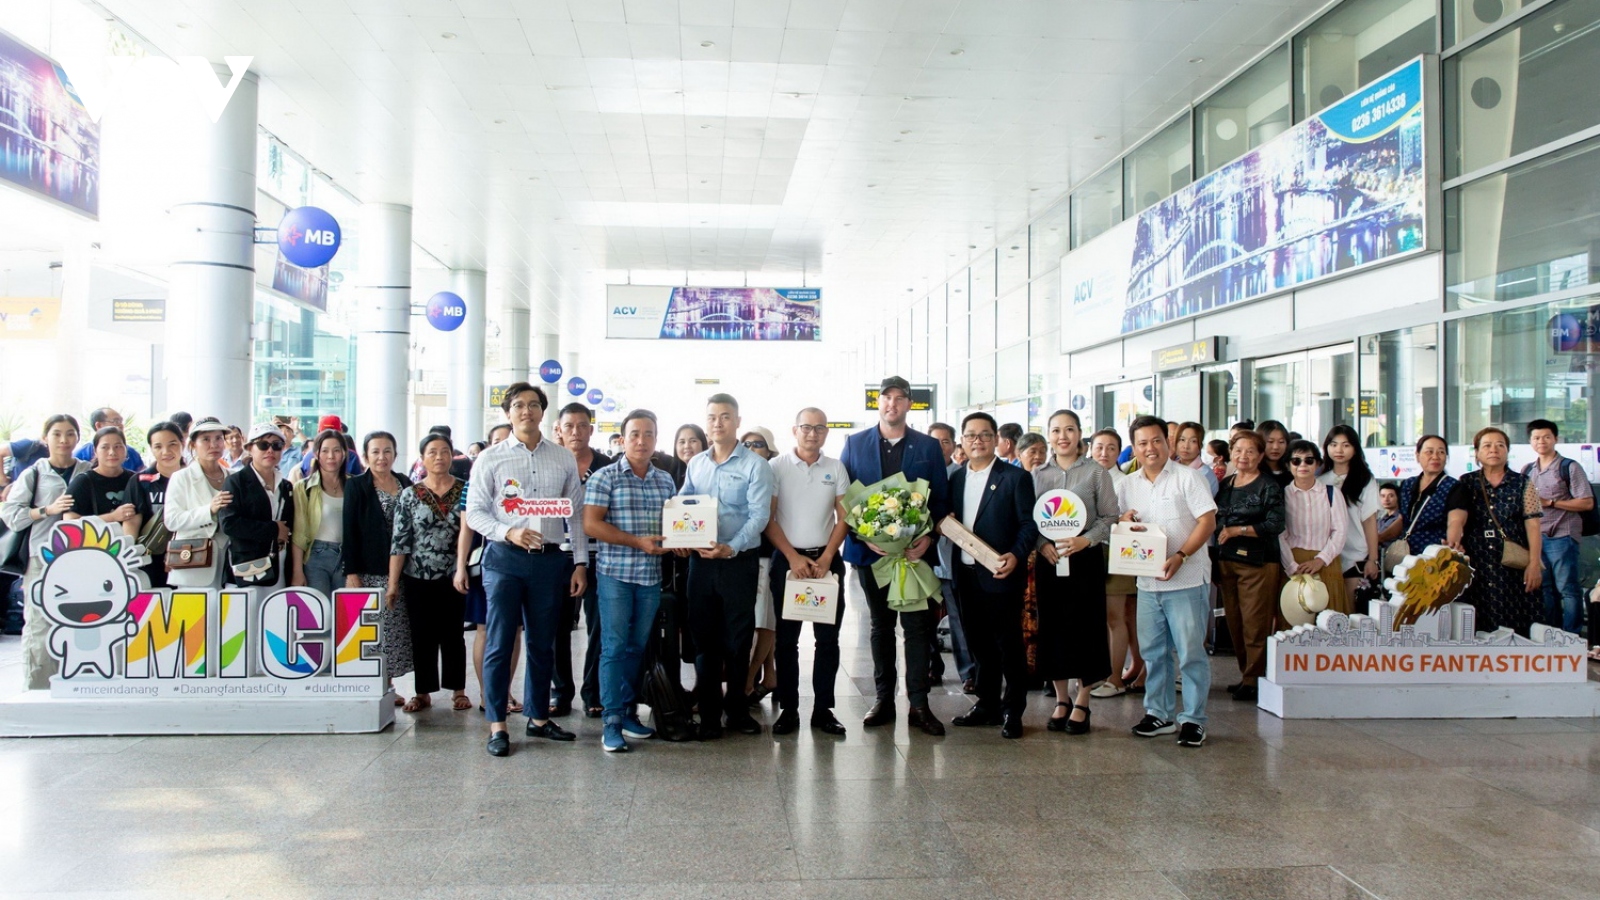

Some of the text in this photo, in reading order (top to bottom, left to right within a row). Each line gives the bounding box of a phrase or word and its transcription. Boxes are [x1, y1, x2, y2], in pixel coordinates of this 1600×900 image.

[304, 229, 335, 246] MB
[1073, 277, 1094, 305] ACV
[443, 305, 464, 317] MB
[613, 306, 638, 315] ACV
[1191, 341, 1207, 362] A3
[518, 506, 571, 516] DANANG
[1040, 519, 1080, 528] DANANG
[125, 591, 381, 680] MICE
[1284, 653, 1582, 673] IN DANANG FANTASTICITY
[73, 684, 159, 696] #miceindanang
[305, 683, 371, 693] #dulichmice
